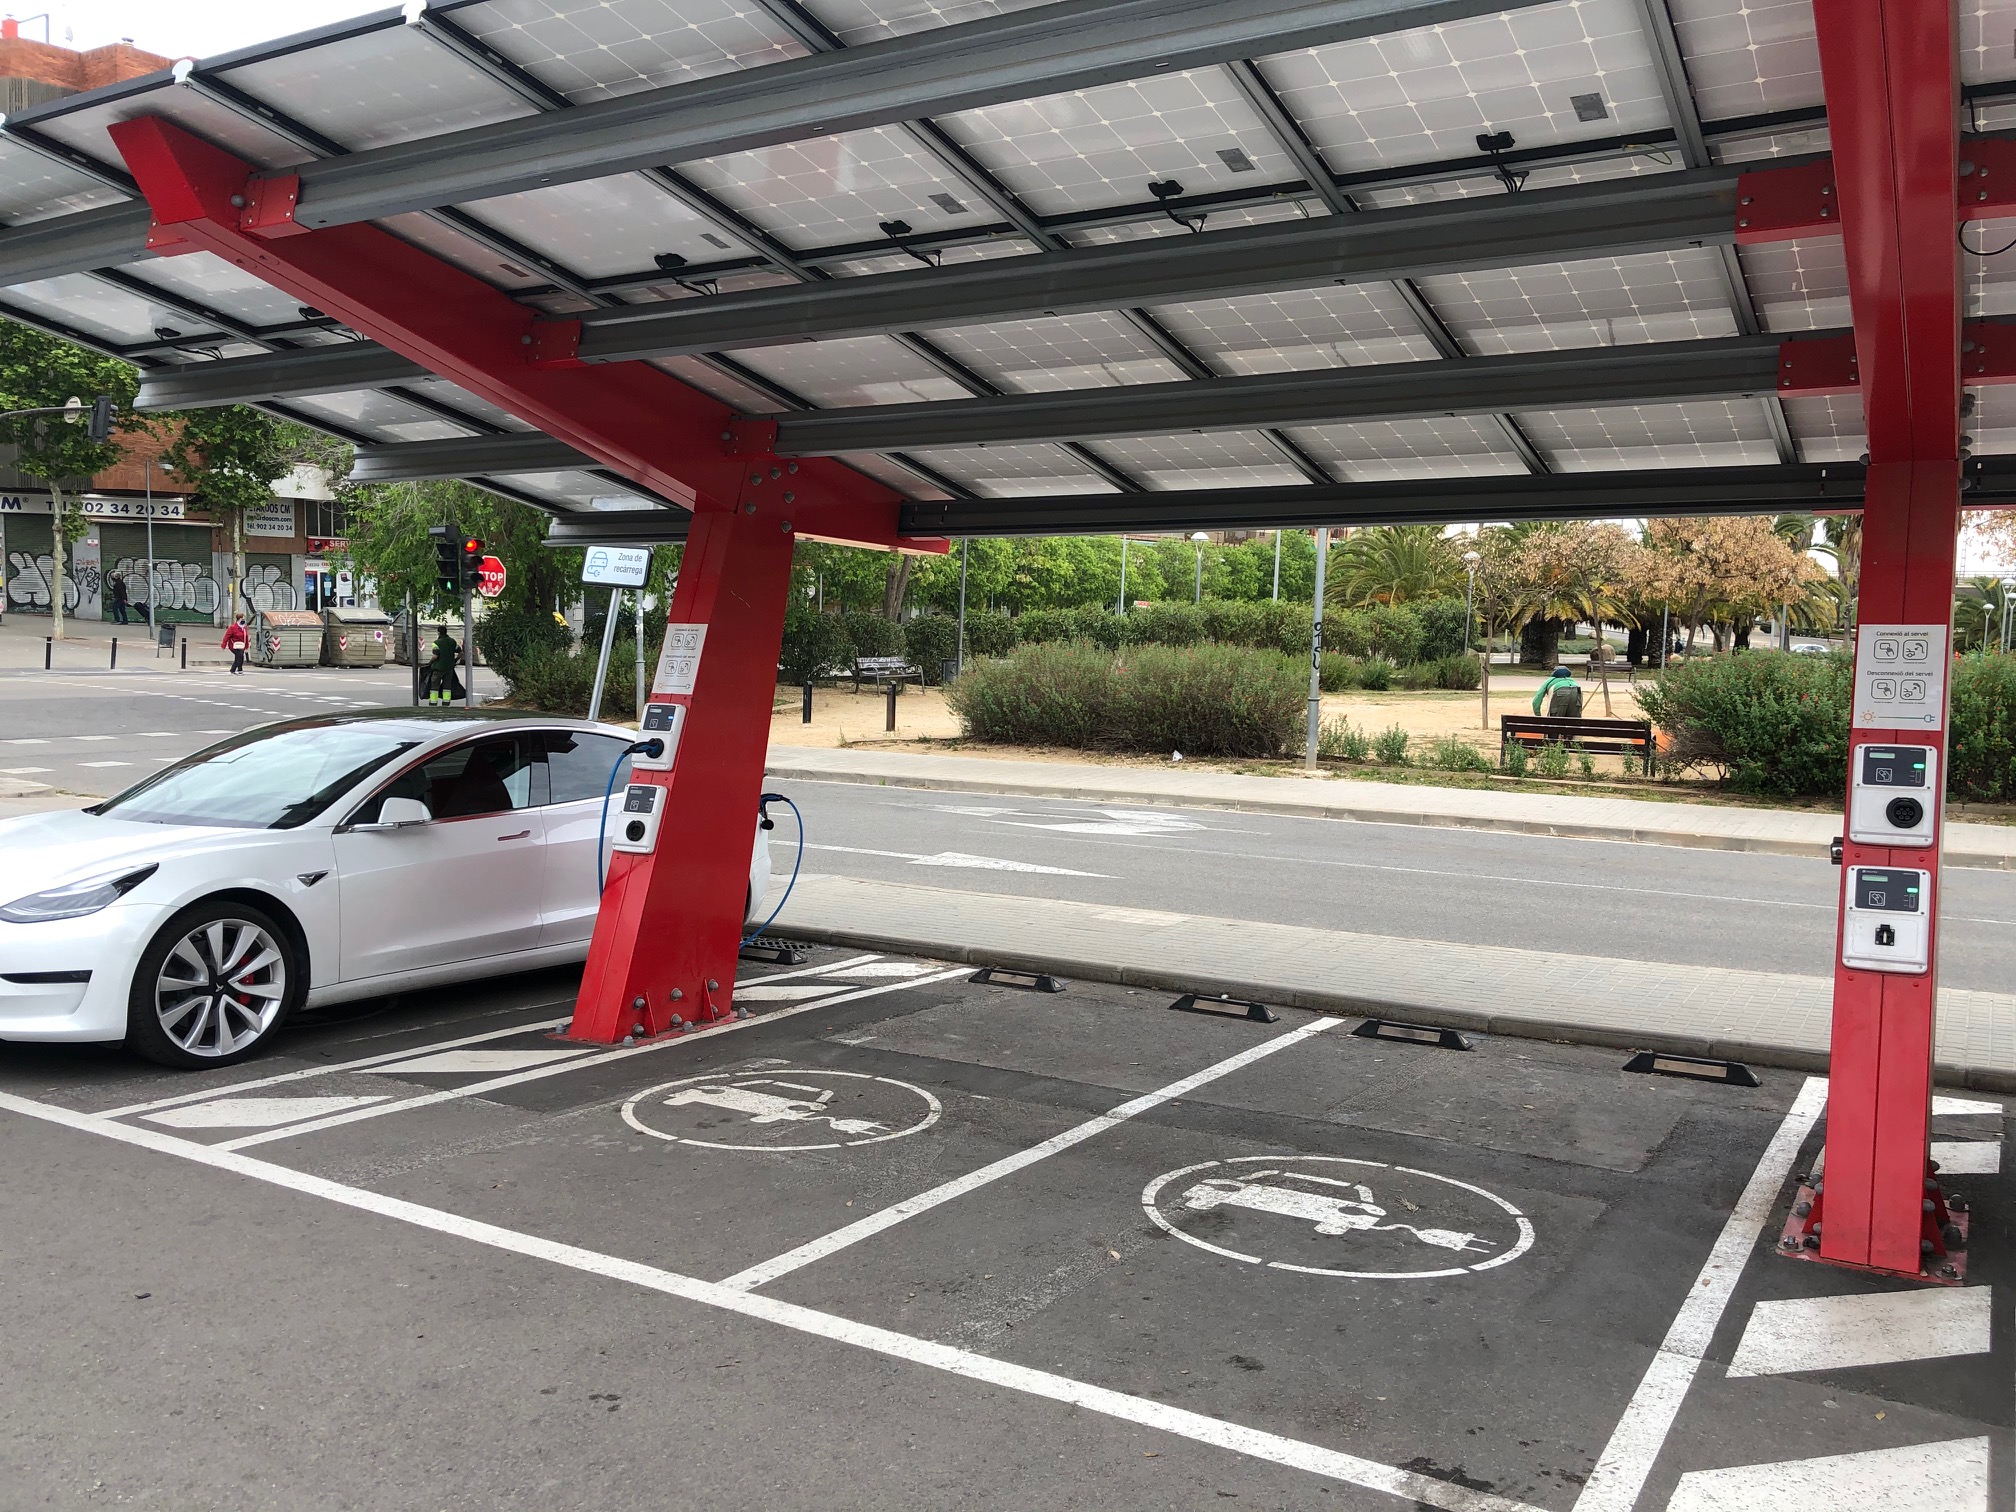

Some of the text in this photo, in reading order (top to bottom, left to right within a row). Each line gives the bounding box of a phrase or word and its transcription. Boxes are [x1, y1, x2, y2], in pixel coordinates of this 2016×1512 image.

[46, 501, 67, 511] Tl
[77, 501, 104, 513] 02
[110, 503, 130, 514] 34
[135, 504, 155, 515] 20
[160, 505, 180, 516] 34
[246, 503, 279, 513] ARDOS
[618, 553, 643, 562] Zona de
[613, 565, 643, 575] recárrega
